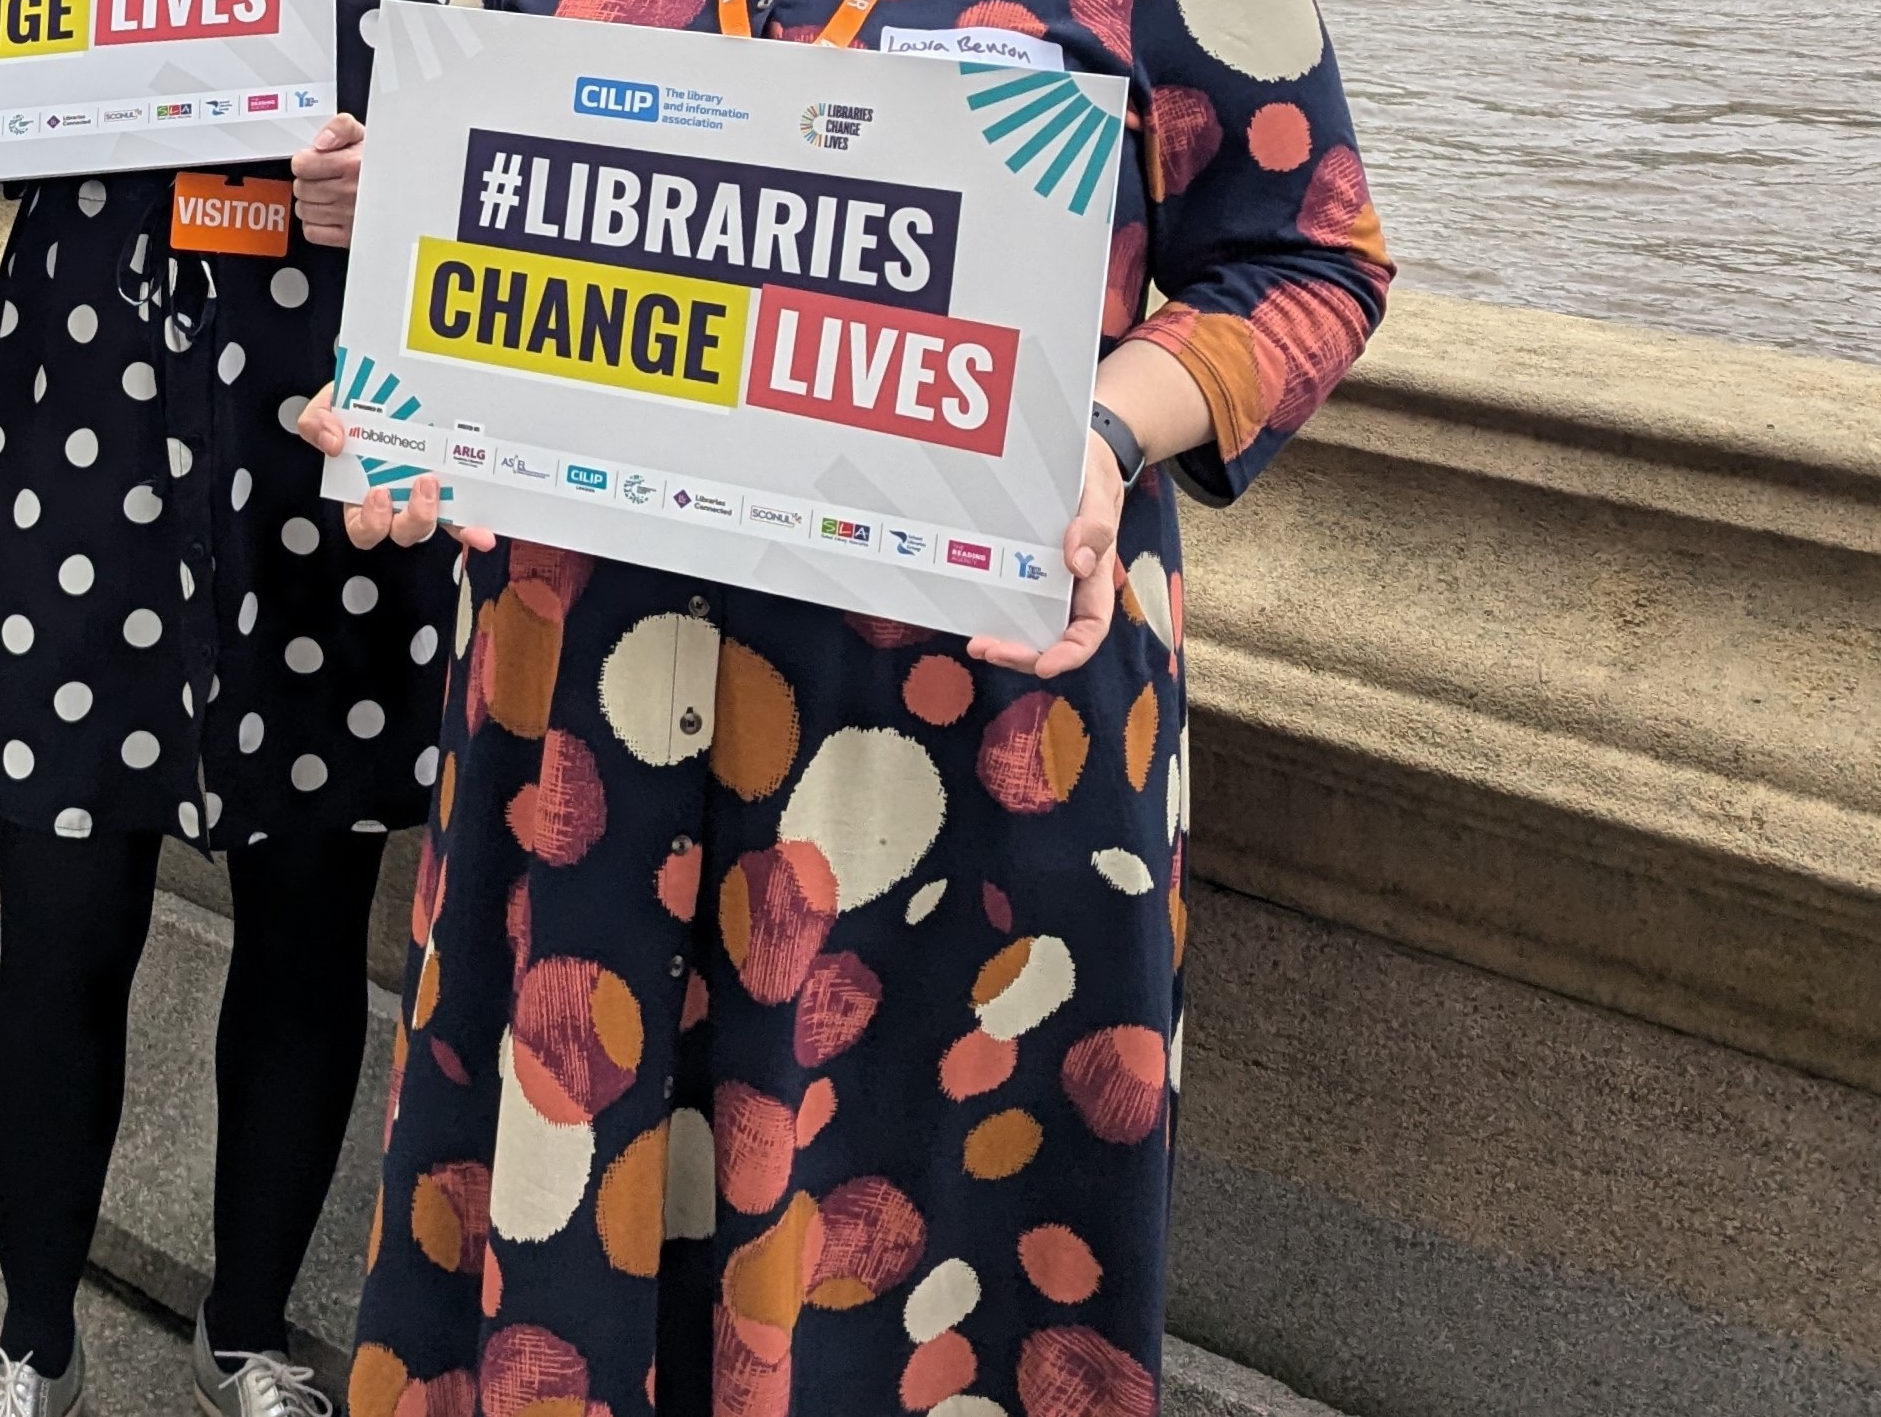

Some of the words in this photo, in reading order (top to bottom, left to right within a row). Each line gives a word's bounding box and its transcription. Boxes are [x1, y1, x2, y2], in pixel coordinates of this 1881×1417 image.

[887, 35, 950, 52] Laura
[957, 35, 1031, 64] Benson
[581, 85, 654, 113] CILIP
[665, 87, 684, 100] The
[687, 90, 723, 105] library
[663, 101, 683, 113] and
[685, 103, 750, 120] information
[827, 103, 874, 123] LIBRARIES
[661, 115, 723, 130] association
[826, 120, 861, 137] CHANGE
[824, 134, 849, 150] LIVES
[178, 195, 286, 232] VISITOR
[478, 151, 934, 294] #LIBRARIES
[429, 260, 727, 385] CHANGE
[769, 308, 994, 431] LIVES
[361, 428, 426, 452] bibliotheca
[453, 444, 486, 460] ARLG
[570, 470, 604, 485] CILIP
[693, 502, 733, 517] Connected
[695, 494, 726, 507] Libraries
[751, 508, 791, 523] SCONUL
[822, 520, 869, 540] SLA
[951, 549, 987, 562] READING
